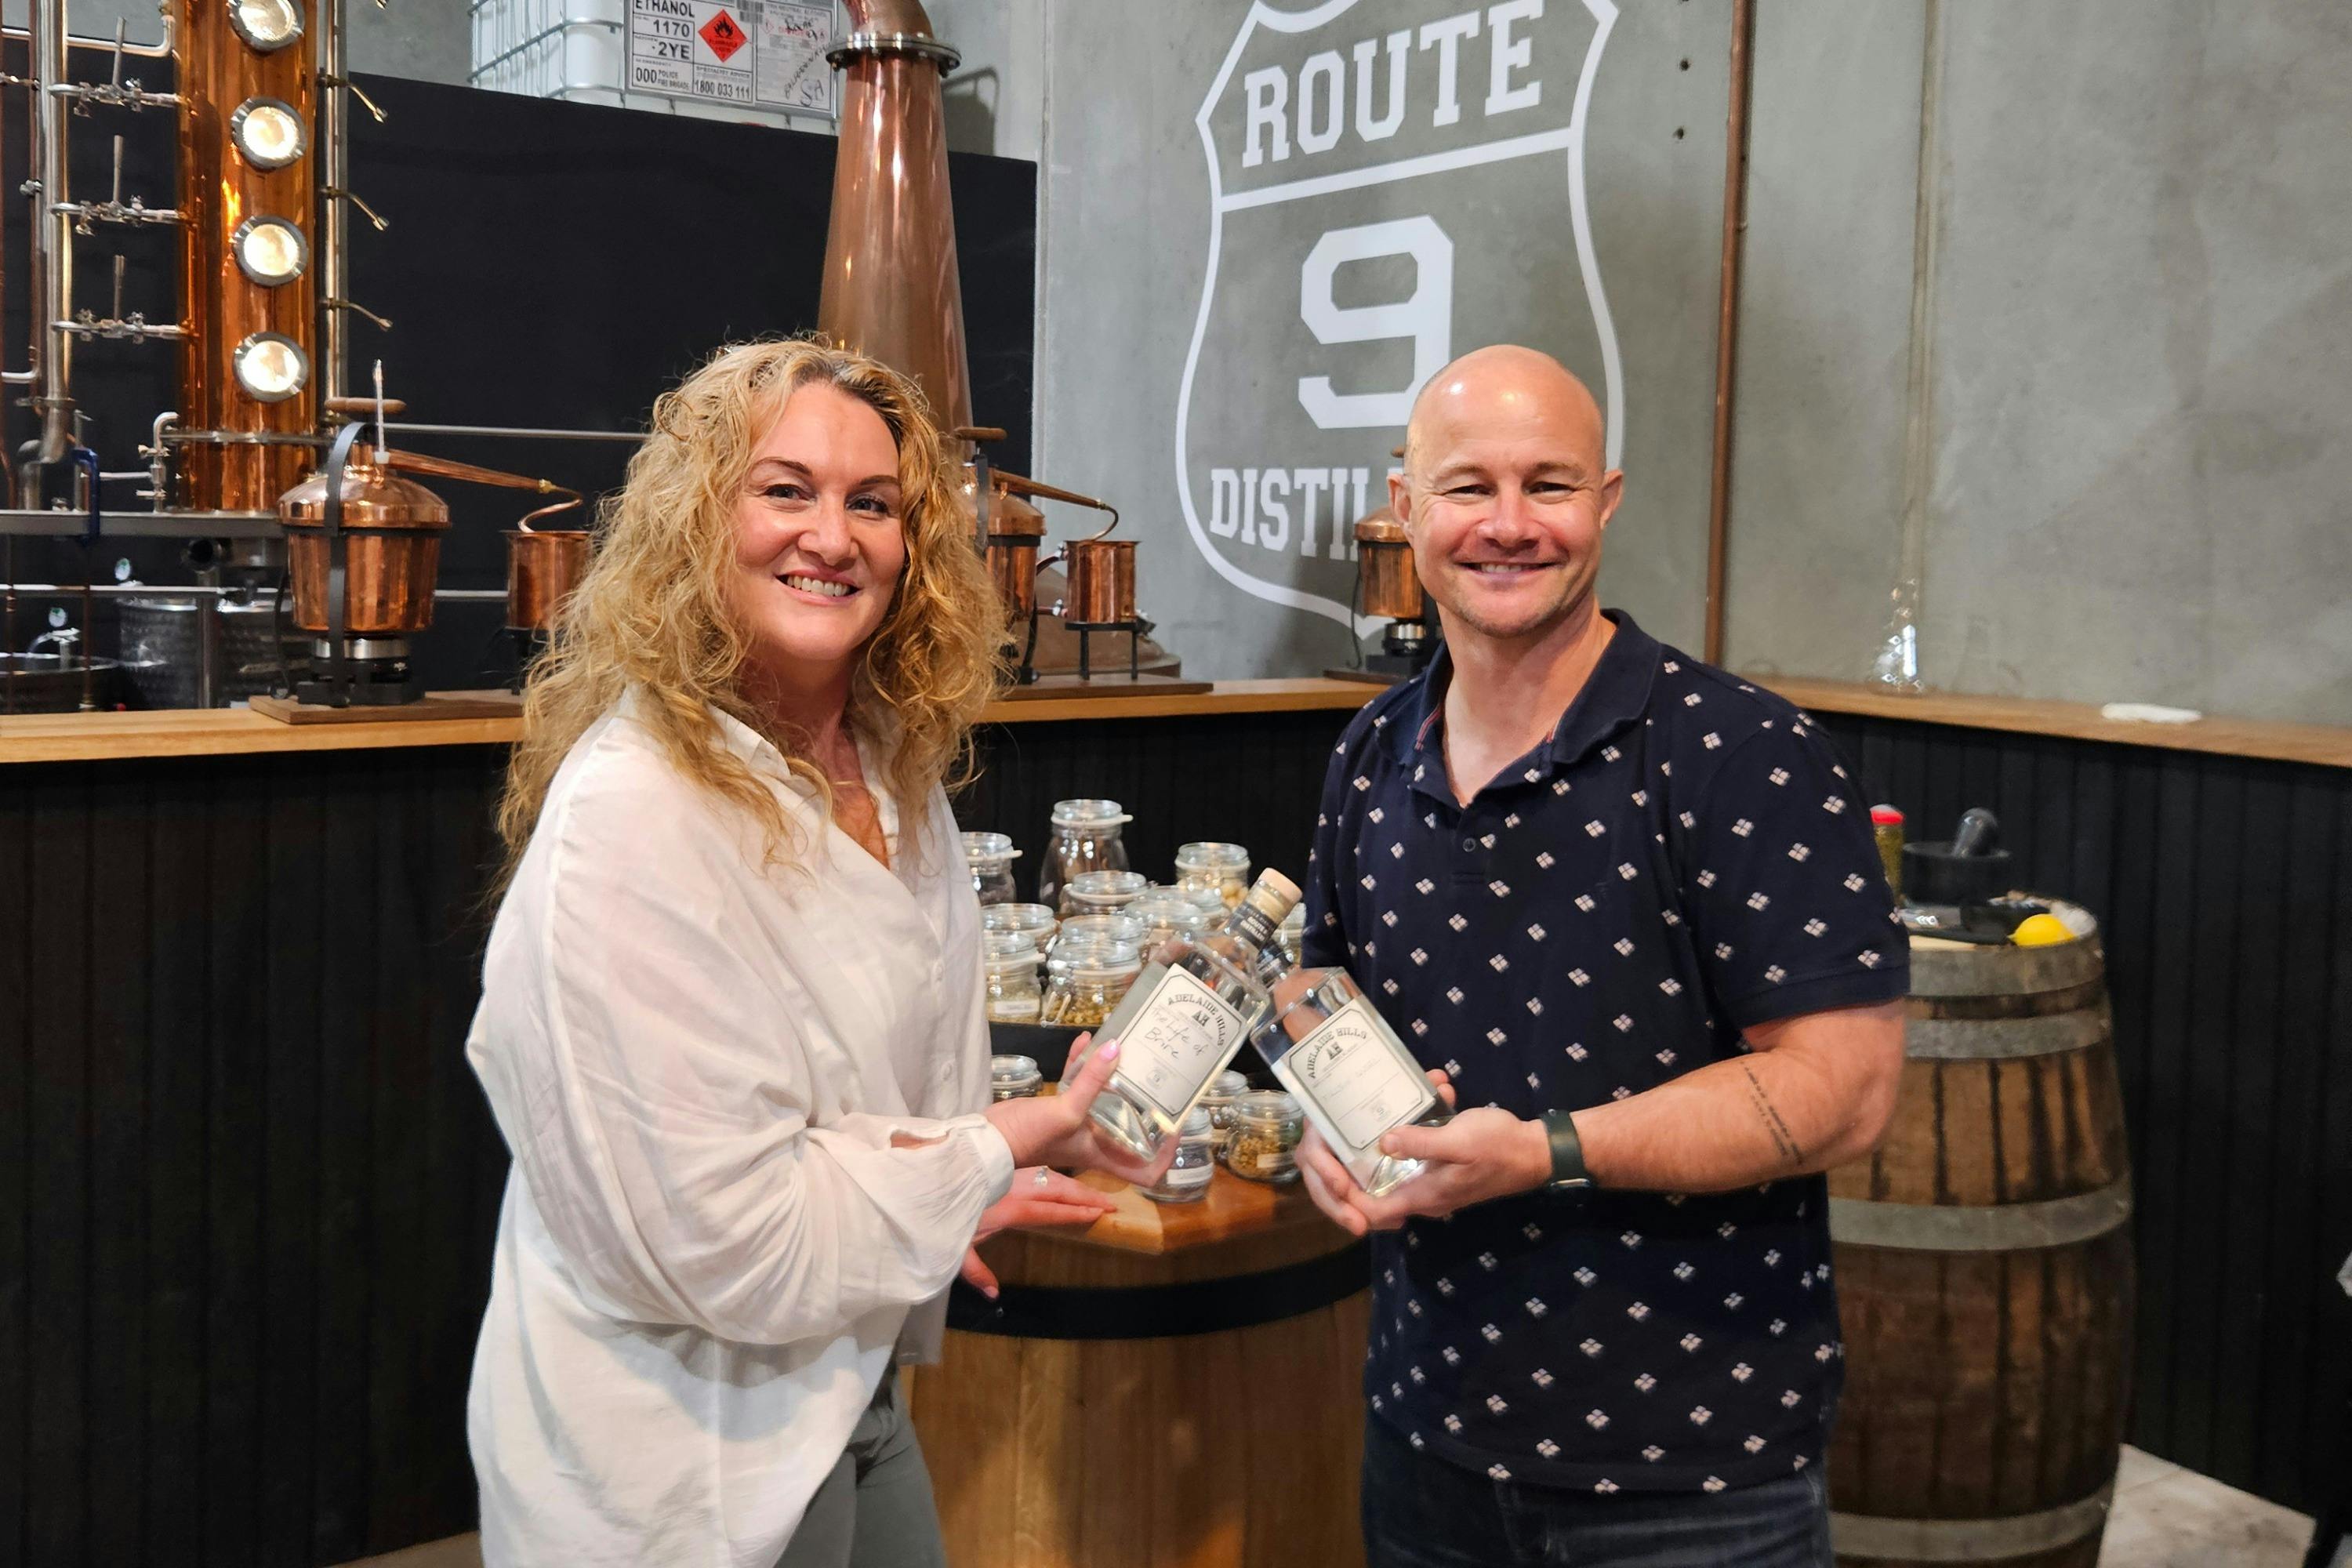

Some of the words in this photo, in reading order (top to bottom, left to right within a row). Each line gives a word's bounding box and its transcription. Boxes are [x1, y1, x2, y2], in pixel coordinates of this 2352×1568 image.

[636, 0, 695, 18] ETHANOL
[653, 19, 690, 38] 1170
[636, 67, 657, 83] 000
[695, 79, 715, 95] 1800
[717, 82, 733, 97] 033
[735, 85, 750, 100] 111
[1242, 0, 1544, 168] ROUTE
[1298, 215, 1454, 429] 9
[1210, 467, 1403, 561] DISTIL
[1167, 993, 1218, 1015] ADELAIDE
[1215, 1014, 1228, 1047] HILLS
[1193, 1042, 1209, 1056] of
[1307, 1031, 1335, 1079] ADELAIDE
[1336, 1027, 1367, 1040] HILLS
